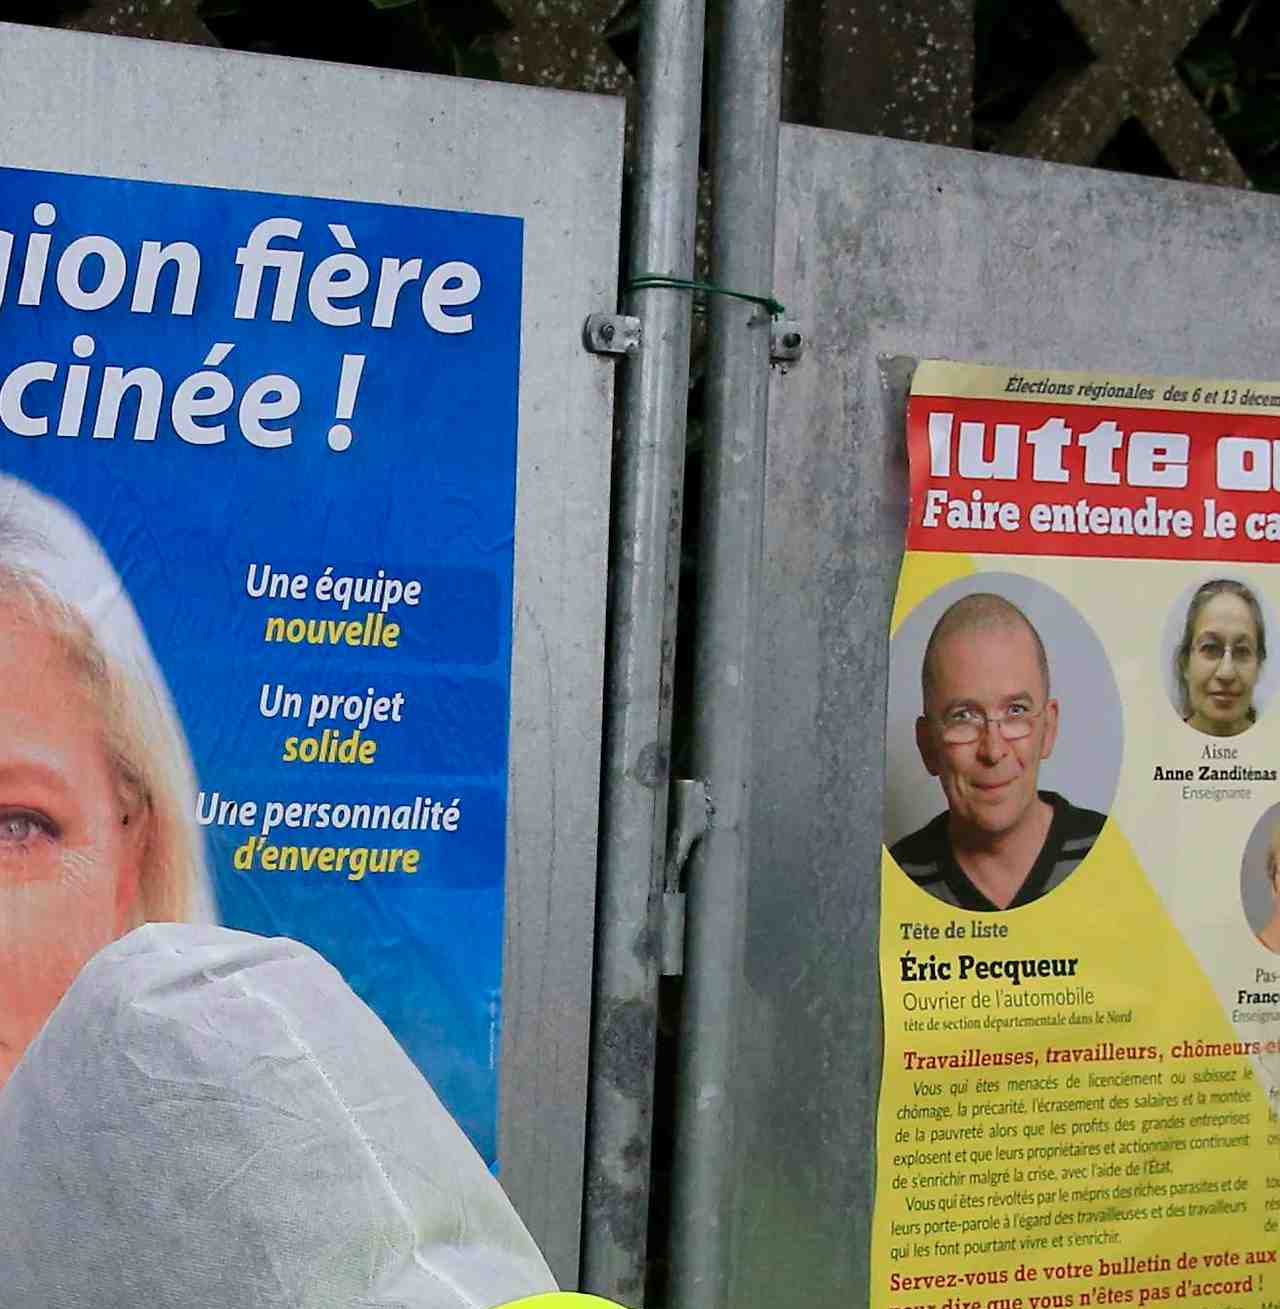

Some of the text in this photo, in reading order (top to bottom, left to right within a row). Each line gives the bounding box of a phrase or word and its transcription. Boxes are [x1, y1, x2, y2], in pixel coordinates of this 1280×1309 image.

[234, 216, 482, 334] fière
[328, 354, 368, 452] !
[1077, 382, 1153, 401] régionales
[1163, 385, 1188, 402] des
[1192, 388, 1201, 403] 6
[1204, 391, 1219, 404] et
[1222, 390, 1237, 405] 13
[928, 412, 1190, 488] lutte
[922, 489, 1019, 530] Faire
[1029, 497, 1192, 537] entendre
[1203, 499, 1236, 539] le
[246, 564, 422, 612] Une équipe
[265, 613, 400, 647] nouvelle
[259, 684, 405, 729] Un projet
[283, 729, 377, 765] solide
[1201, 744, 1238, 760] Aisne
[1154, 766, 1194, 781] Anne
[196, 792, 462, 836] Une personnalité
[900, 921, 1008, 940] Tête de liste
[900, 950, 1079, 986] Éric Pecqueur
[903, 991, 966, 1011] Ouvrier
[971, 990, 991, 1009] de
[904, 1018, 924, 1031] tête
[926, 1018, 939, 1031] de
[943, 1016, 981, 1029] section
[1068, 1010, 1092, 1026] dans
[1095, 1011, 1105, 1023] le
[1106, 1010, 1132, 1023] Nord
[904, 1049, 1039, 1070] Travailleuses,
[1046, 1040, 1164, 1064] travailleurs,
[1171, 1038, 1260, 1058] chômeurs
[890, 1244, 910, 1261] qui
[913, 1243, 930, 1257] les
[934, 1241, 960, 1256] font
[964, 1238, 1016, 1257] pourtant
[1020, 1235, 1049, 1250] vivre
[1051, 1235, 1063, 1248] et
[890, 1249, 1277, 1291] Servez-vous de votre bulletin de vote aux
[1029, 1294, 1074, 1309] vous
[1139, 1286, 1170, 1306] pas
